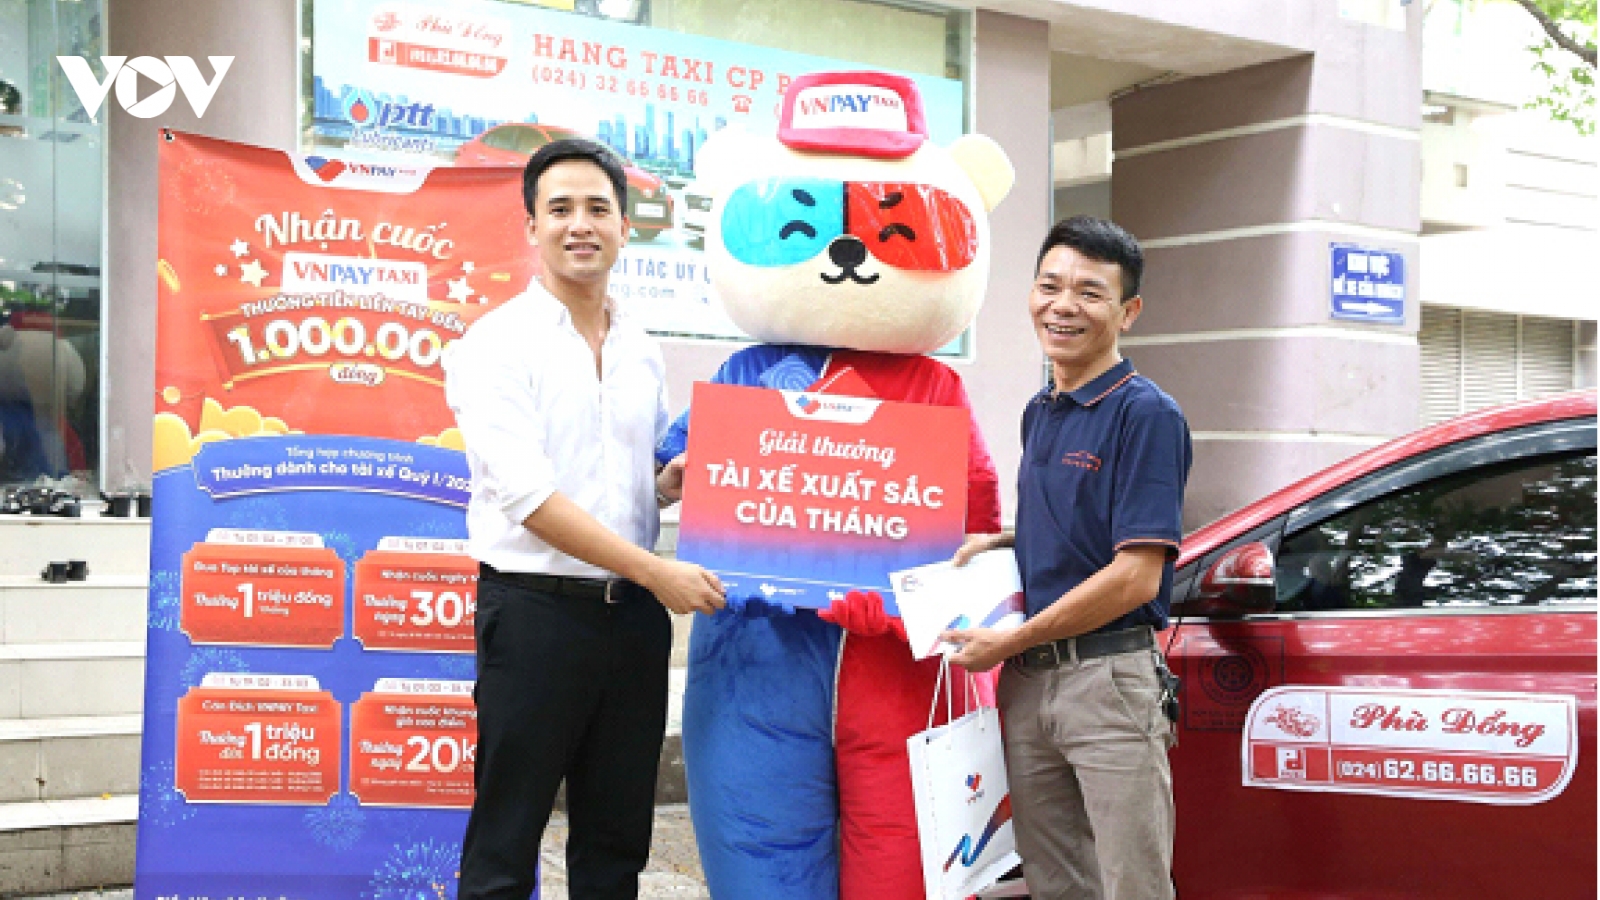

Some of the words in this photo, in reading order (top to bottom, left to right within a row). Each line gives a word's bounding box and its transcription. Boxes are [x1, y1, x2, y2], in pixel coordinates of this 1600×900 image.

[532, 64, 586, 91] (024)
[596, 74, 618, 94] 32
[626, 79, 649, 98] 66
[657, 84, 680, 102] 66
[687, 89, 709, 107] 66
[640, 50, 715, 85] TAXI
[726, 66, 765, 92] CP
[379, 102, 436, 128] ptt
[255, 208, 364, 251] Nhận
[371, 221, 455, 260] cuốc
[227, 316, 450, 368] 1.000.00
[759, 428, 809, 457] Giải
[811, 436, 896, 469] thưởng
[212, 462, 273, 483] Thưởng
[276, 460, 316, 477] dành
[319, 462, 348, 476] cho
[351, 462, 373, 478] tài
[376, 460, 397, 479] xế
[398, 468, 431, 486] Quý
[706, 459, 751, 489] TÀI
[757, 463, 798, 493] XẾ
[800, 470, 877, 502] XUẤT
[883, 475, 944, 509] SẮC
[735, 496, 797, 528] CỦA
[806, 506, 909, 541] THÁNG
[237, 582, 253, 619] 1
[1349, 703, 1429, 732] Phù
[244, 722, 262, 761] 1
[265, 722, 315, 746] triệu
[264, 741, 321, 766] đồng
[1337, 758, 1381, 779] (024)
[1384, 758, 1538, 788] 62.66.66.66
